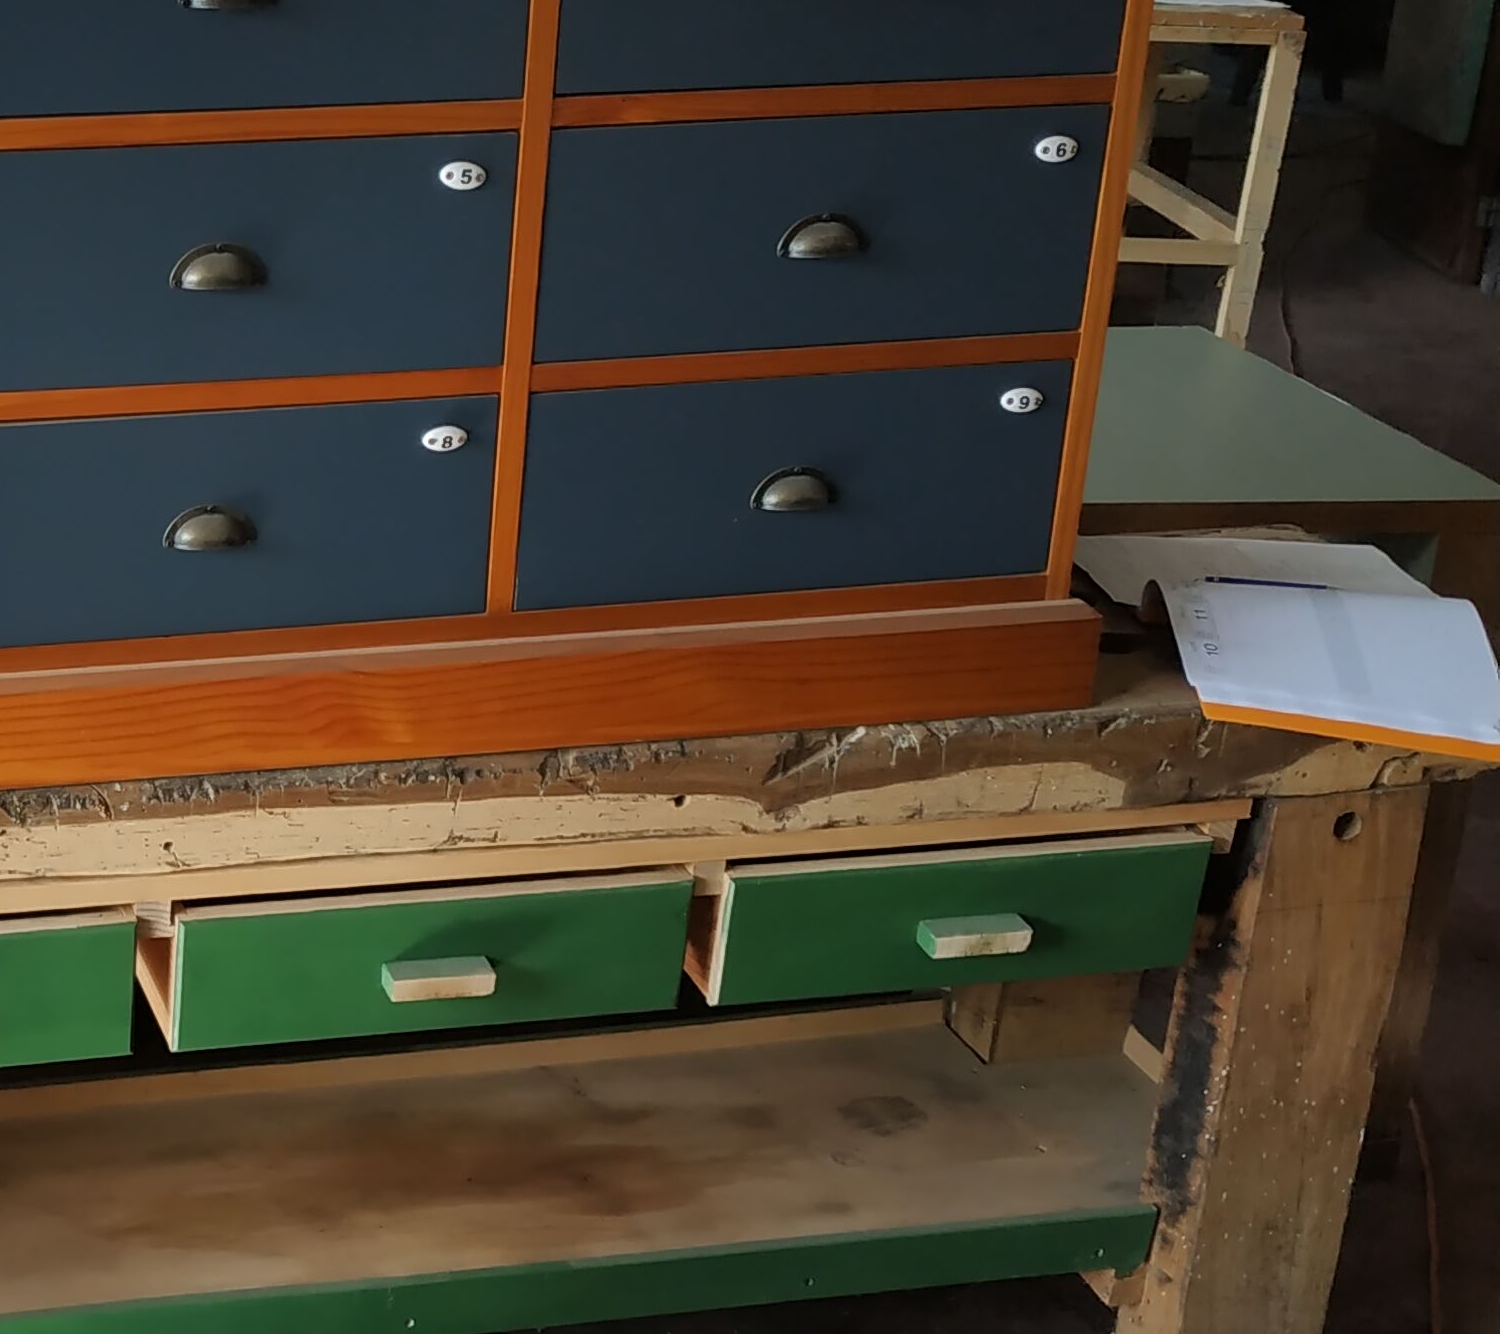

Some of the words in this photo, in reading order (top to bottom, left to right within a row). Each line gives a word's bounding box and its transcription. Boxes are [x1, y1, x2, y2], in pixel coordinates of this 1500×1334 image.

[1056, 142, 1067, 158] 6
[460, 168, 473, 184] 5
[1018, 396, 1030, 409] 9
[441, 435, 453, 449] 8
[1203, 642, 1220, 657] 10
